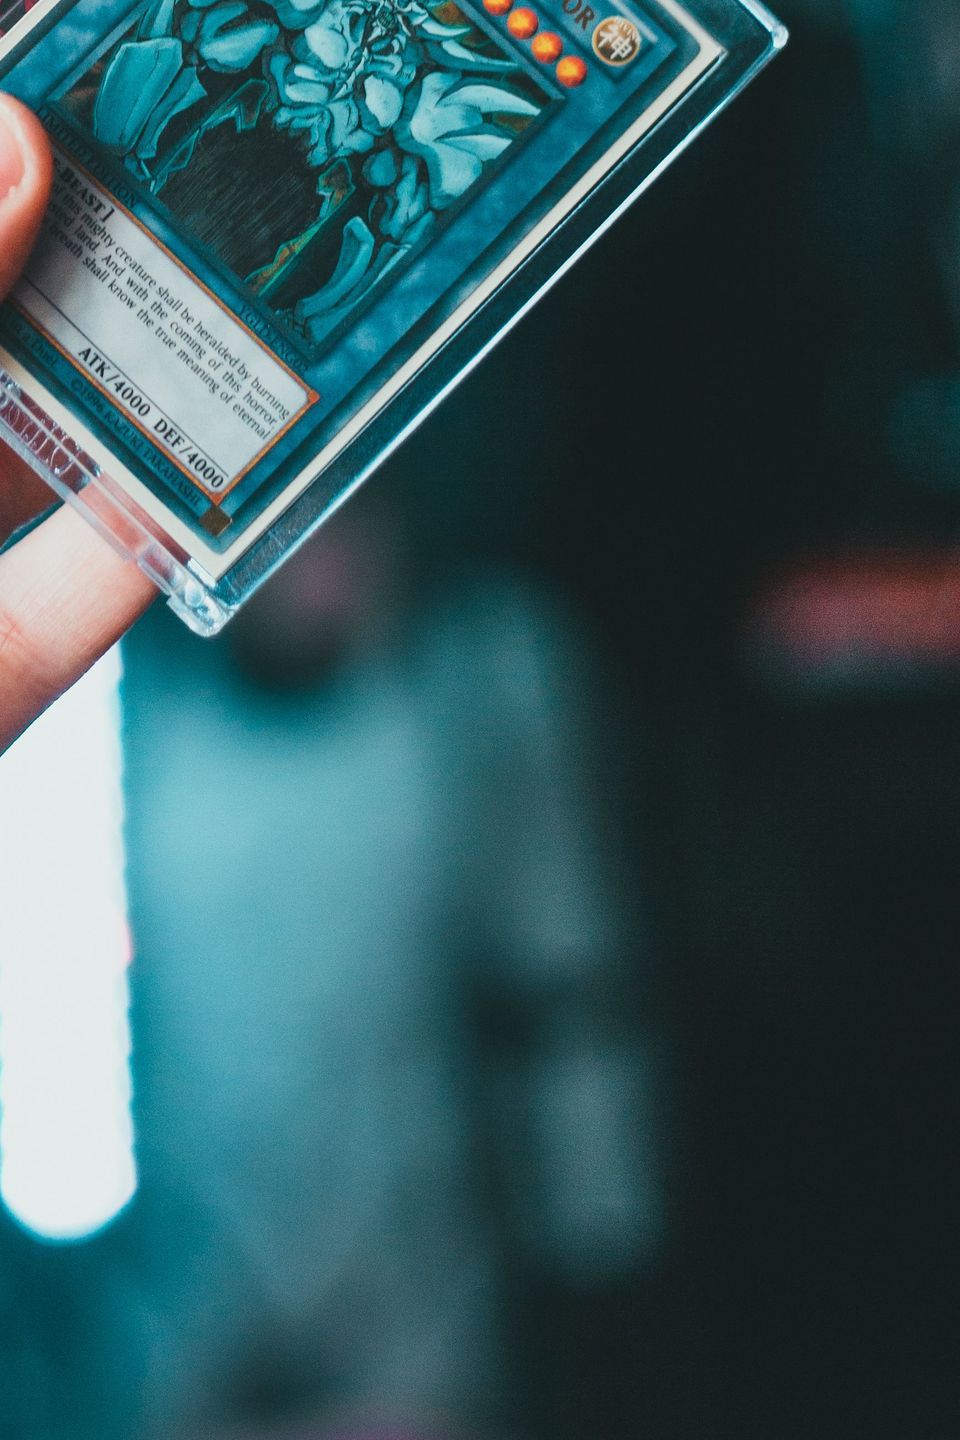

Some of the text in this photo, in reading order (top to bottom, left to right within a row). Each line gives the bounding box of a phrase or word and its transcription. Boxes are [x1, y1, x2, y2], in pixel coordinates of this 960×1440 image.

[597, 27, 631, 60] 神
[46, 221, 272, 441] breath shall know the true meaning of eternal
[60, 191, 85, 216] this
[77, 210, 118, 250] mighty
[111, 244, 159, 289] creature
[153, 282, 185, 313] shall
[178, 306, 198, 326] be
[190, 319, 242, 368] heralded
[233, 362, 254, 383] by
[247, 375, 293, 420] burning
[72, 224, 103, 254] land.
[99, 252, 127, 278] And
[122, 274, 151, 303] with
[148, 298, 172, 321] the
[165, 318, 209, 360] coming
[205, 354, 225, 373] of
[219, 368, 245, 394] this
[239, 389, 282, 430] horror,
[77, 345, 152, 419] ATK/4000
[151, 417, 225, 490] DEF/4000
